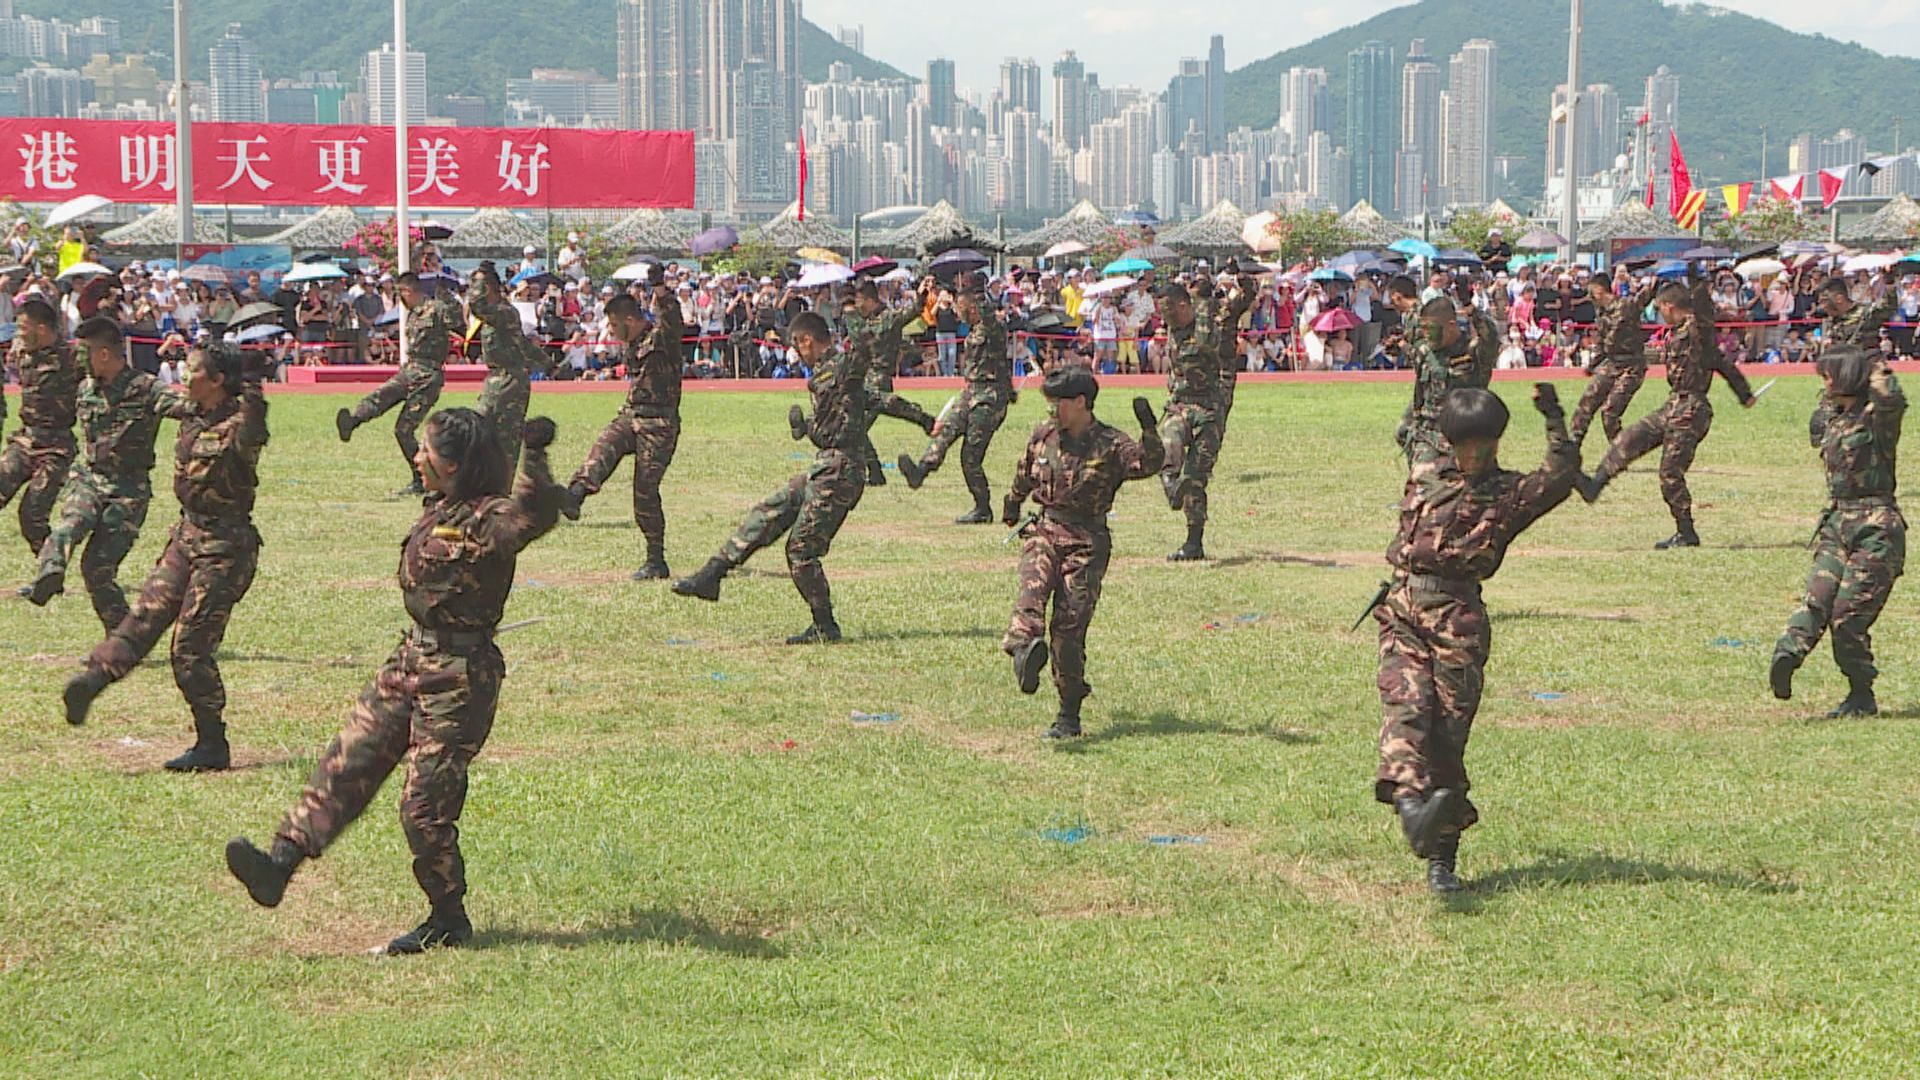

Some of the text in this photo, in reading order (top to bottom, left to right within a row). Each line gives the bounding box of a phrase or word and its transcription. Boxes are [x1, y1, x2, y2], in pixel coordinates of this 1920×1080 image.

[18, 131, 550, 196] 港明天更美好
